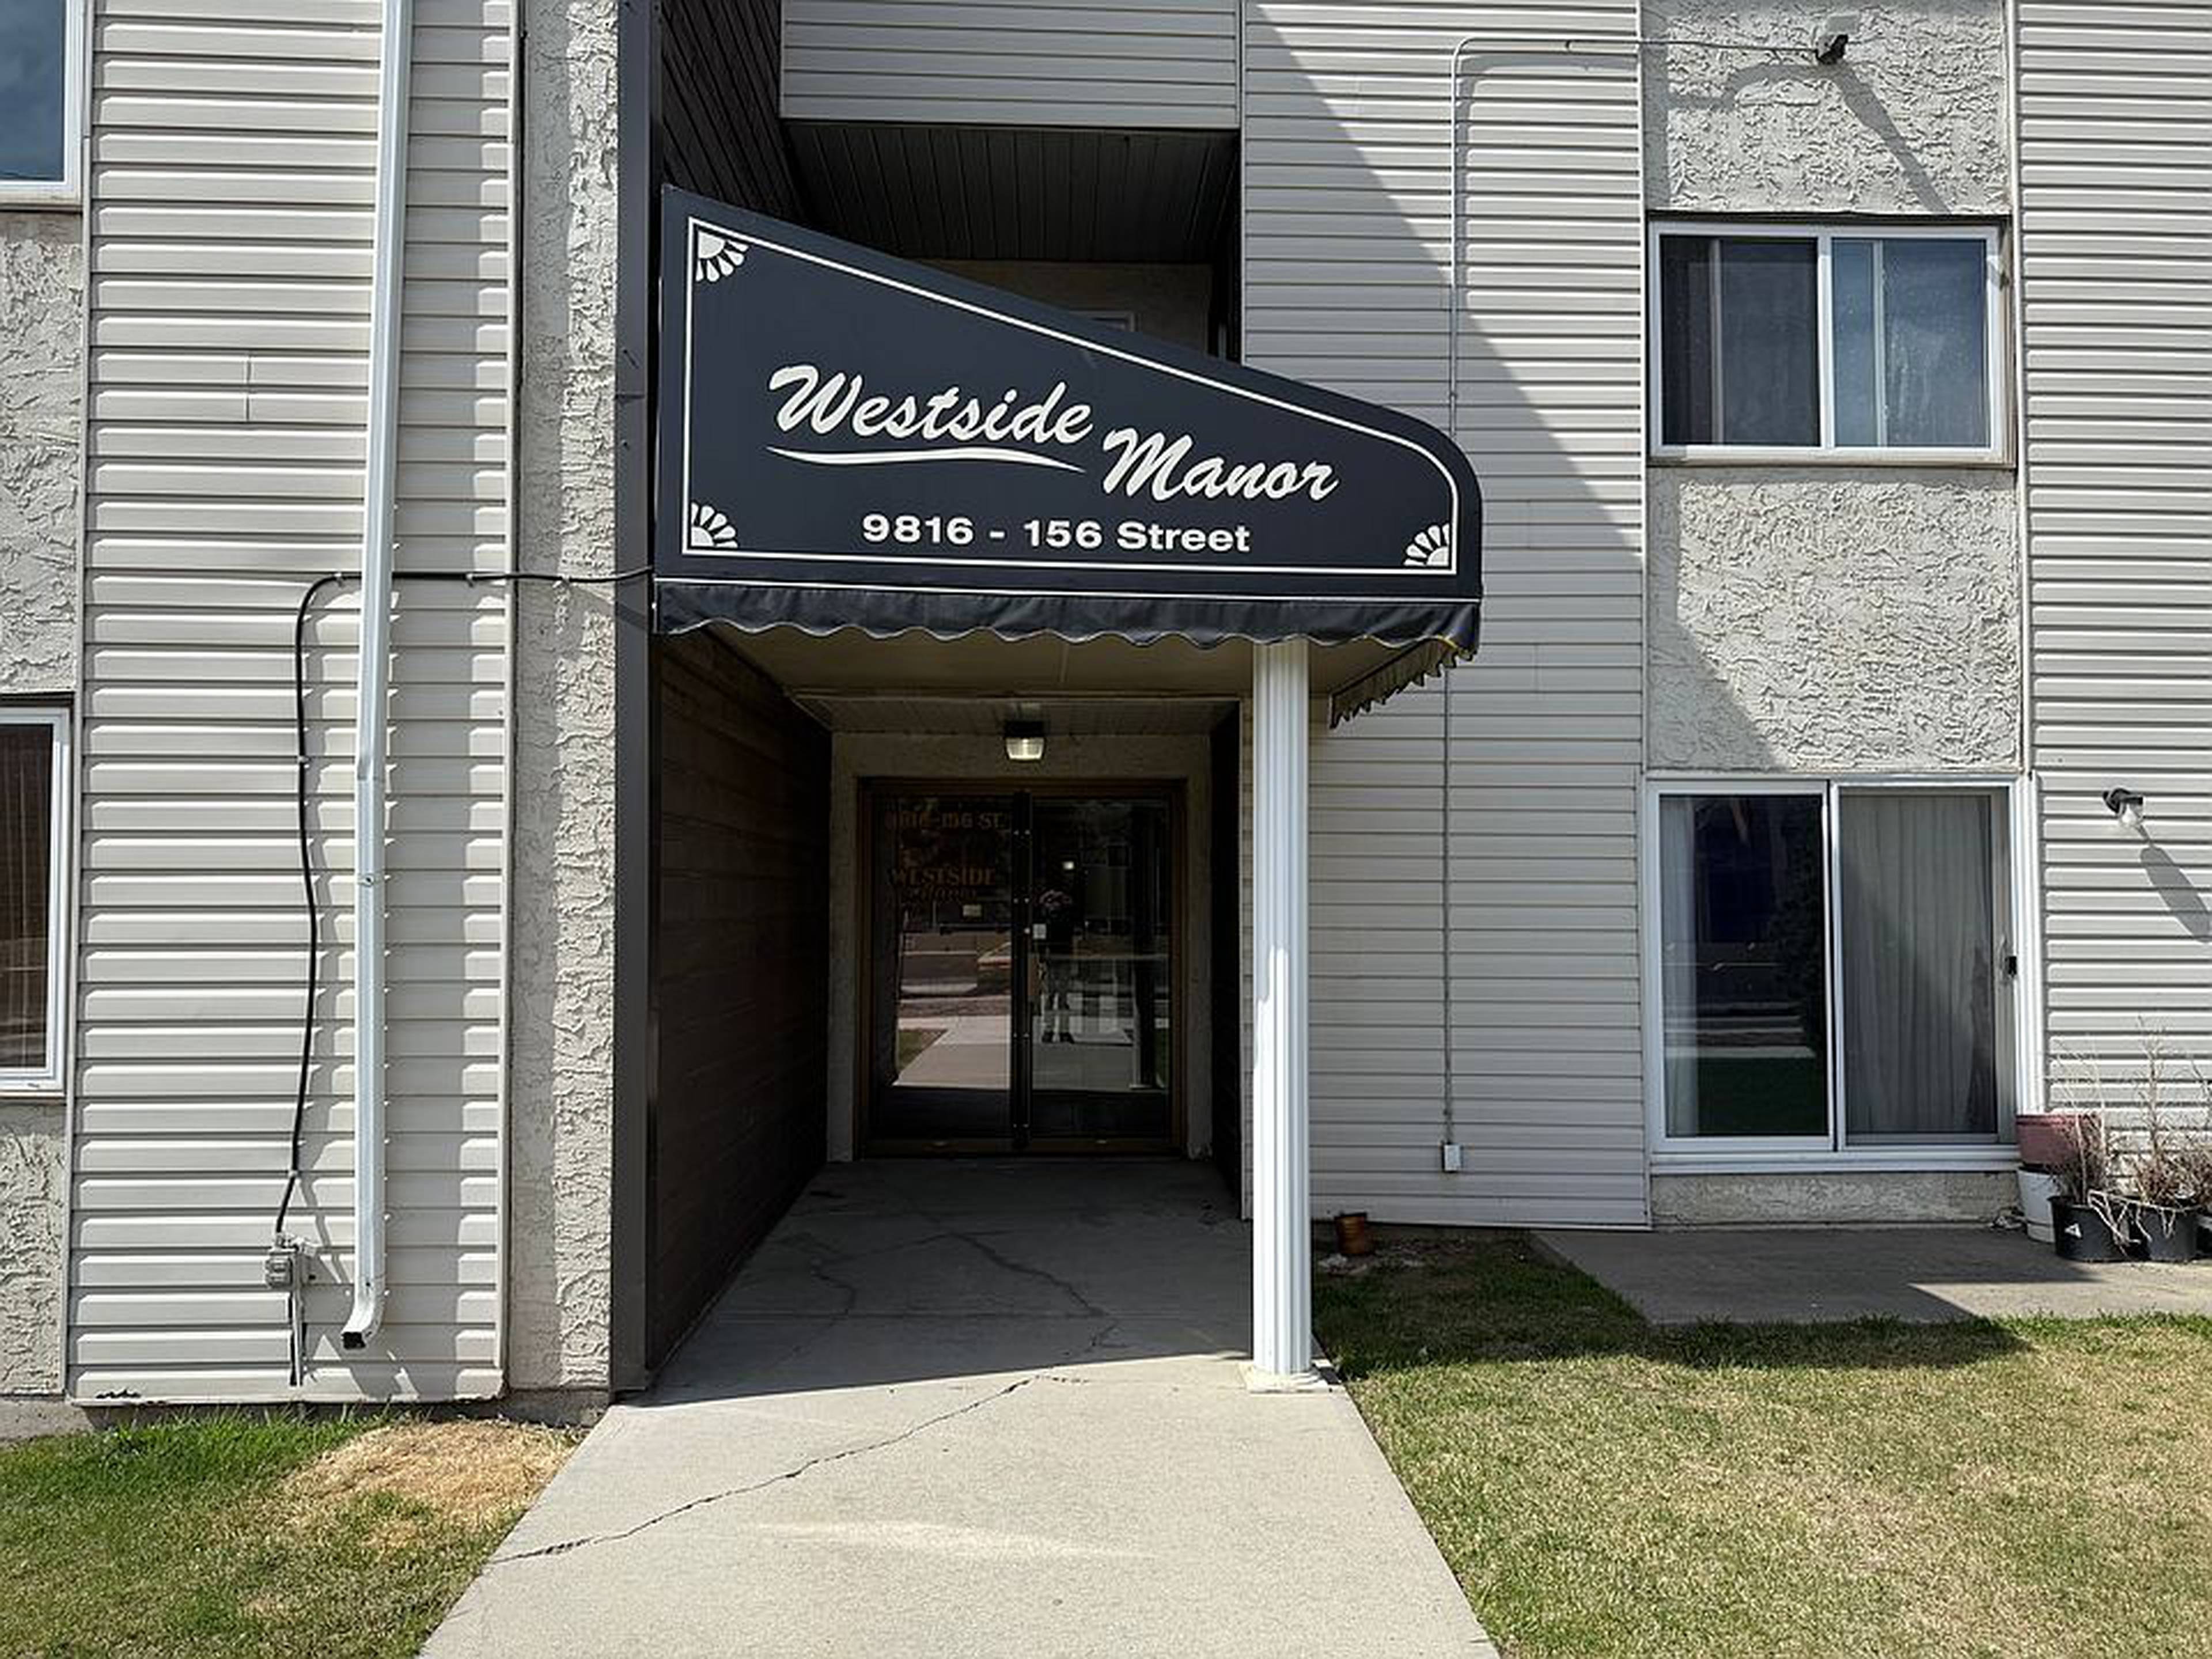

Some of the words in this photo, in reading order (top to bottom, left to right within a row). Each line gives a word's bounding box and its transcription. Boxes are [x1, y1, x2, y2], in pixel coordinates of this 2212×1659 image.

[769, 364, 1093, 444] Westside
[1103, 427, 1339, 501] Manor
[862, 514, 973, 544] 9816
[1024, 520, 1102, 548] 156
[1116, 521, 1251, 552] Street
